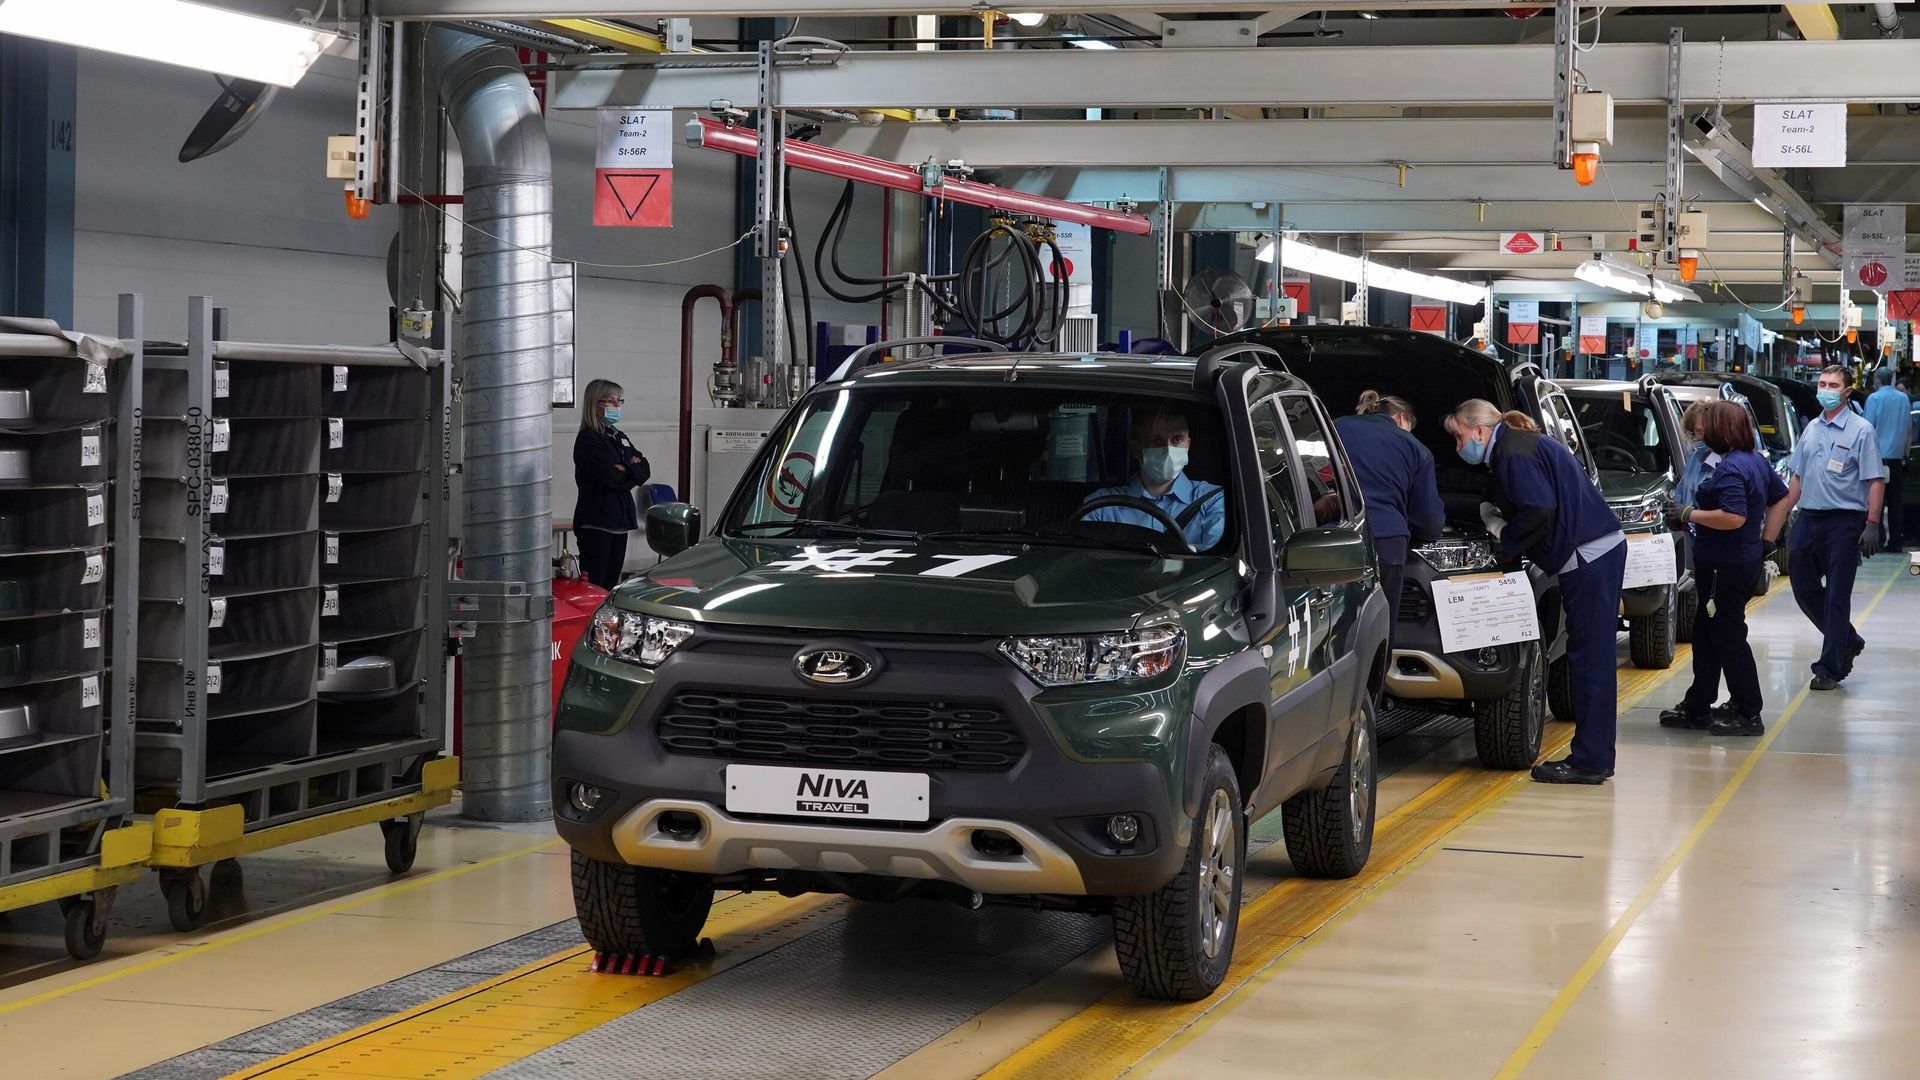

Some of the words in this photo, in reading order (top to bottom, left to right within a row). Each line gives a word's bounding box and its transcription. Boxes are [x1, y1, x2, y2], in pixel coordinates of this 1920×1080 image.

[620, 116, 646, 125] SLAT
[1782, 110, 1814, 120] SLAT
[619, 130, 647, 138] Team-2
[1781, 125, 1815, 134] Team-2
[618, 147, 647, 156] St-56R
[1780, 144, 1814, 154] St-56L
[1863, 209, 1886, 217] SLAT
[1862, 232, 1884, 240] St-55L
[214, 432, 228, 445] 1(2)
[84, 445, 99, 457] 2(4)
[443, 406, 451, 501] SPC-0380-0
[132, 407, 143, 520] SPC-0380-0
[187, 405, 202, 517] SPC-0380-0
[203, 415, 213, 524] PROPERTY
[212, 494, 226, 506] 1(3)
[88, 503, 103, 518] 3(1)
[85, 563, 103, 577] 3(2)
[1447, 595, 1465, 604] LEM
[85, 626, 99, 641] 3(3)
[1287, 597, 1312, 678] #1
[1491, 634, 1501, 642] AC
[83, 685, 98, 700] 3(4)
[185, 689, 197, 718] Инв
[797, 773, 868, 799] NIVA
[802, 802, 864, 813] TRAVEL
